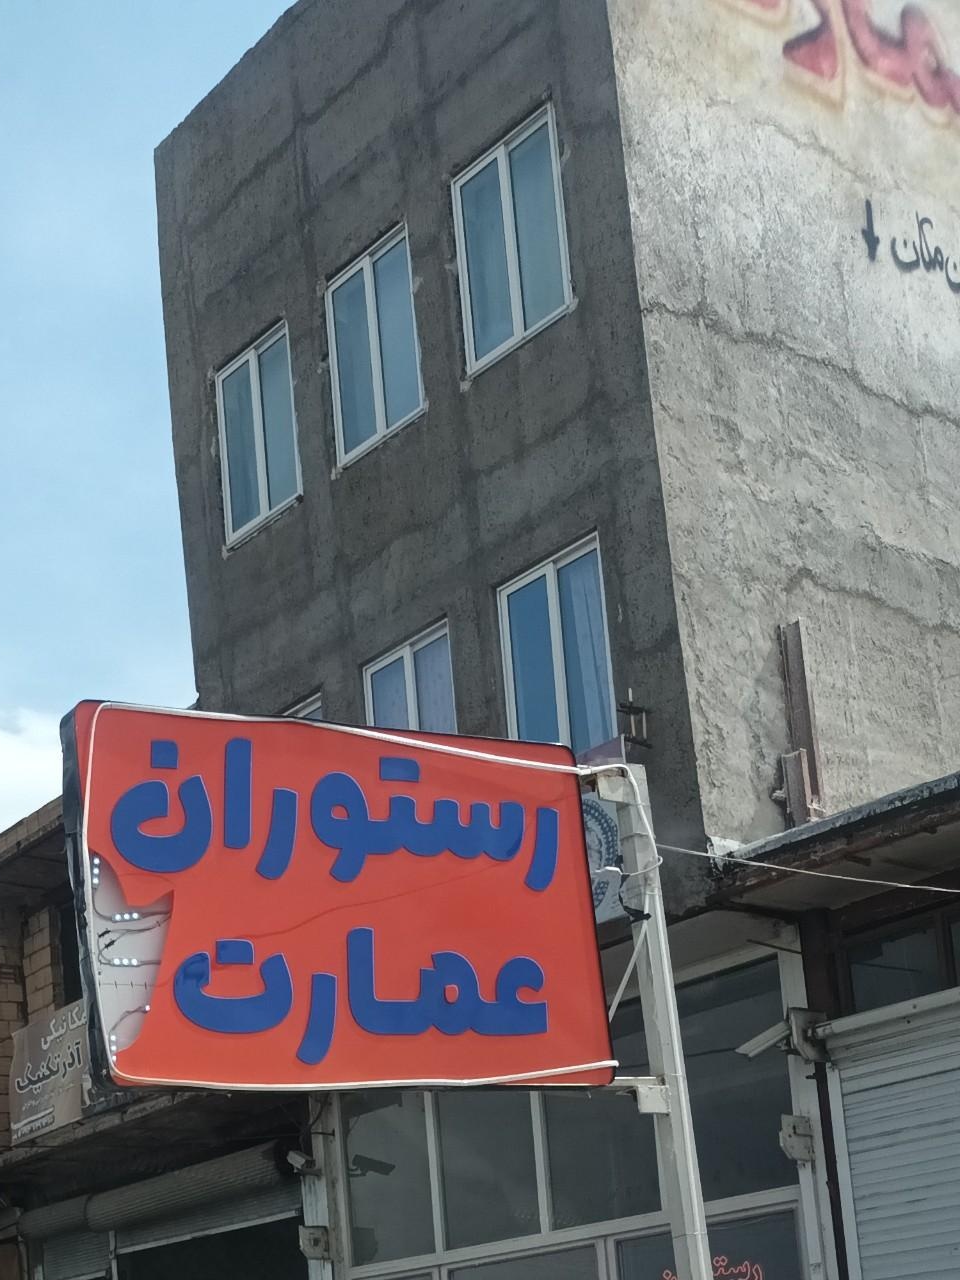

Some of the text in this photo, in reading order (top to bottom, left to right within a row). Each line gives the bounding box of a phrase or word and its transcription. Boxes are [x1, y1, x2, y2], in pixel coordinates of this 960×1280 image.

[890, 209, 945, 273] مکان
[110, 736, 559, 892] رستوران
[173, 926, 548, 1066] عمارت
